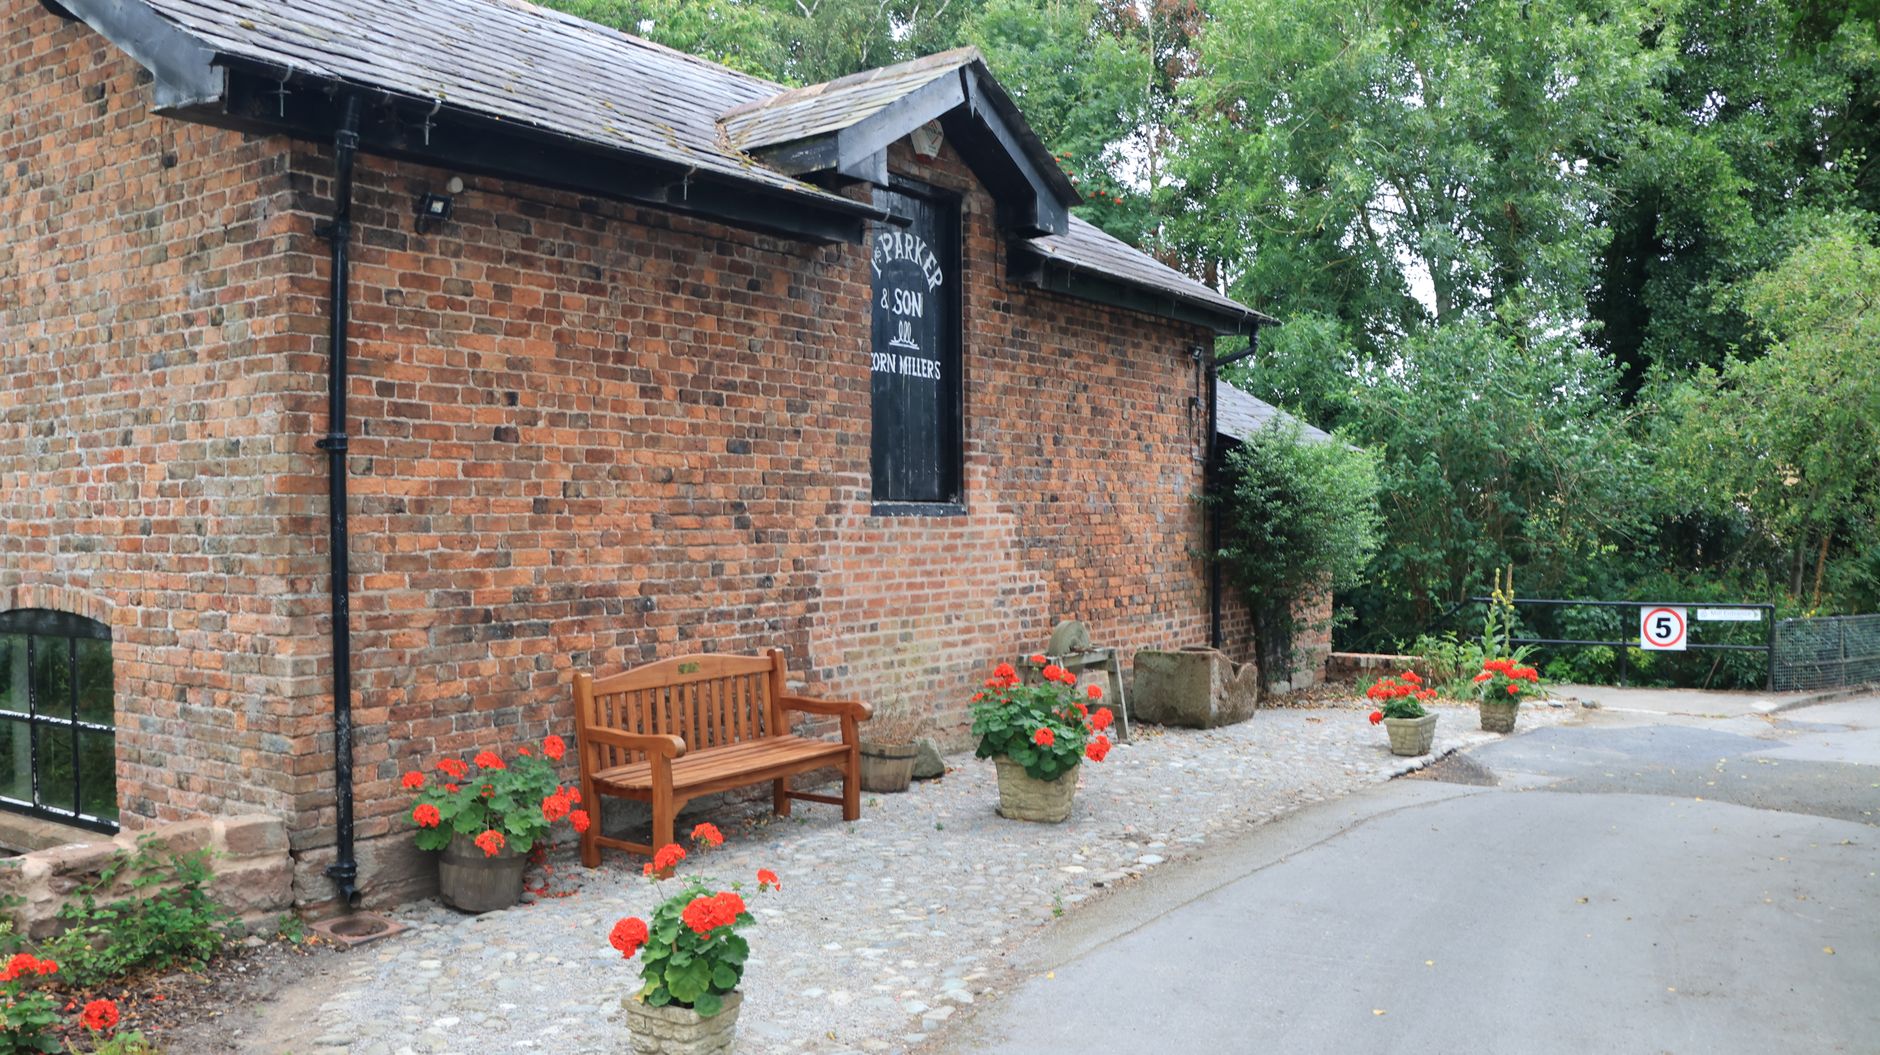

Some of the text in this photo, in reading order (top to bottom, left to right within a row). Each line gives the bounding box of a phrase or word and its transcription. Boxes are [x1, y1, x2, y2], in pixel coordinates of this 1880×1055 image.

[878, 231, 943, 293] PARKER
[880, 287, 923, 318] & SON
[899, 355, 941, 380] MILLERS
[1655, 617, 1672, 639] 5
